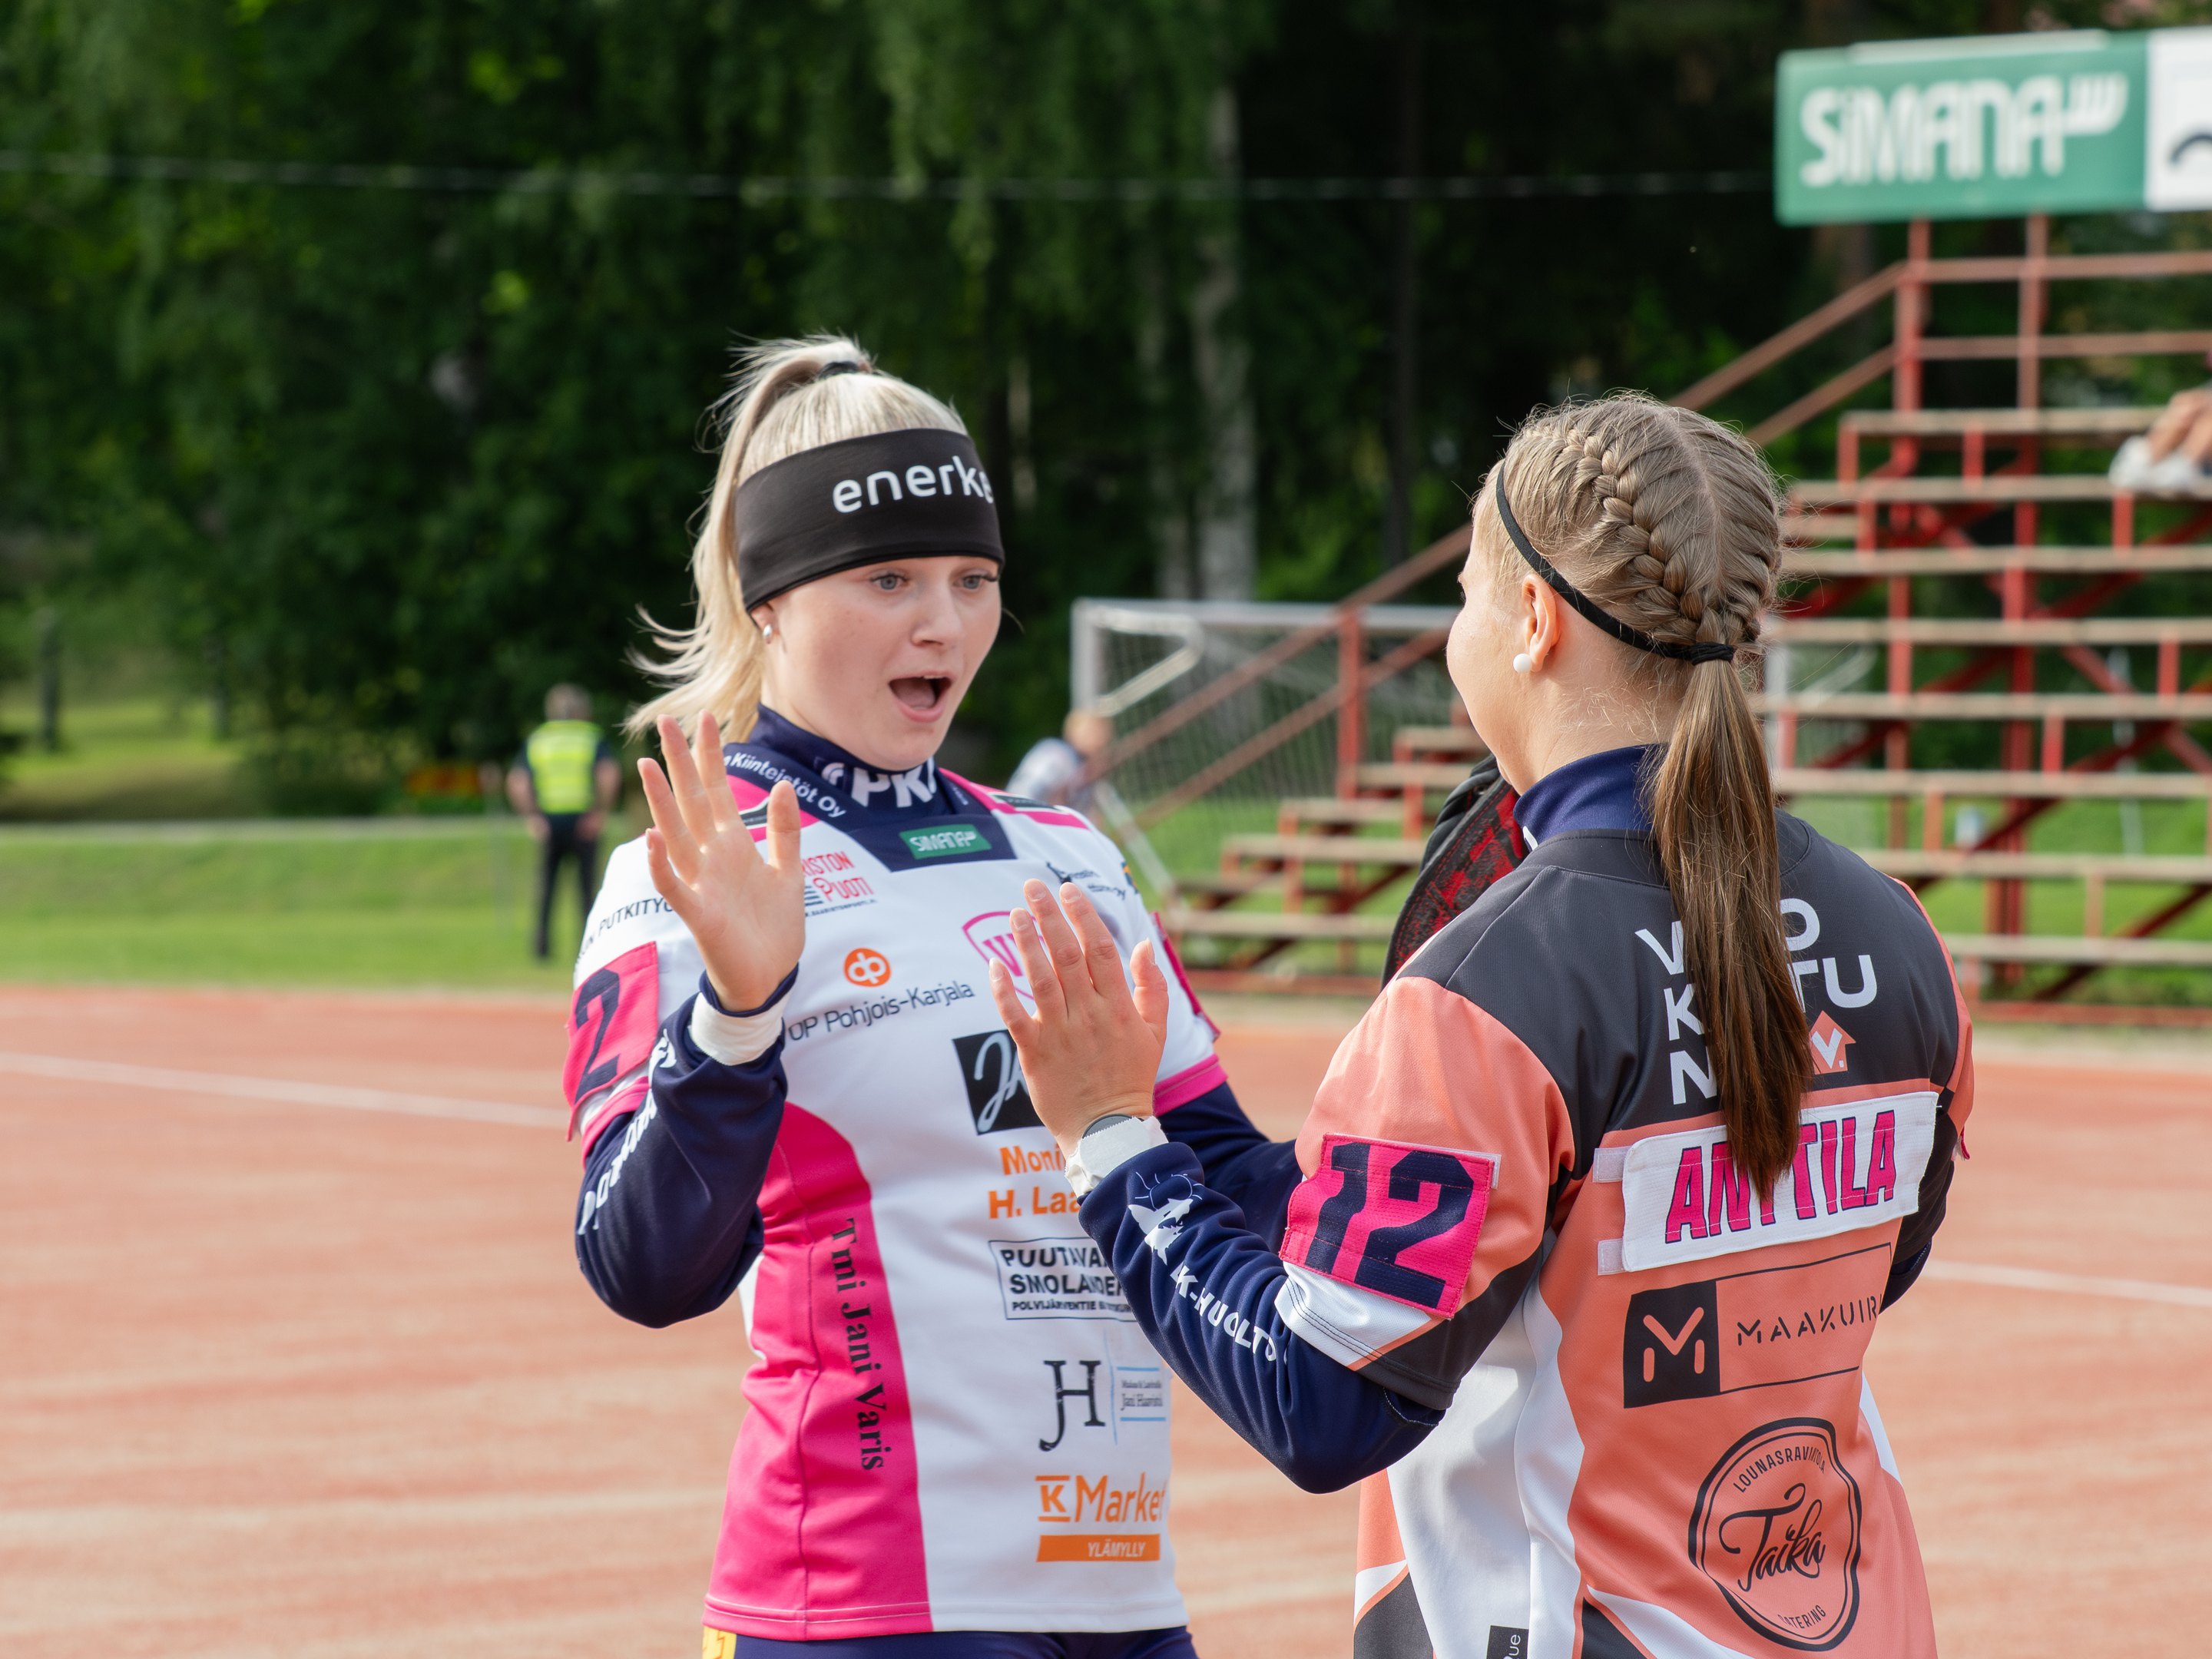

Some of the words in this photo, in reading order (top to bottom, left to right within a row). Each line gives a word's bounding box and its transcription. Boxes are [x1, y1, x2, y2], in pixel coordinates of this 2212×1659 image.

[818, 796, 846, 817] Oy
[824, 981, 975, 1032] Pohjois-Karjala
[999, 1144, 1066, 1176] Moni
[988, 1189, 1022, 1220] H.
[1305, 1141, 1475, 1310] 12
[832, 1218, 866, 1293] Tmi
[841, 1303, 882, 1375] Jani
[854, 1384, 892, 1471] Varis
[1733, 1446, 1825, 1493] LOUNASRAVINTOLA
[1088, 1538, 1146, 1558] YLÄMYLLY
[1718, 1482, 1826, 1592] Taika
